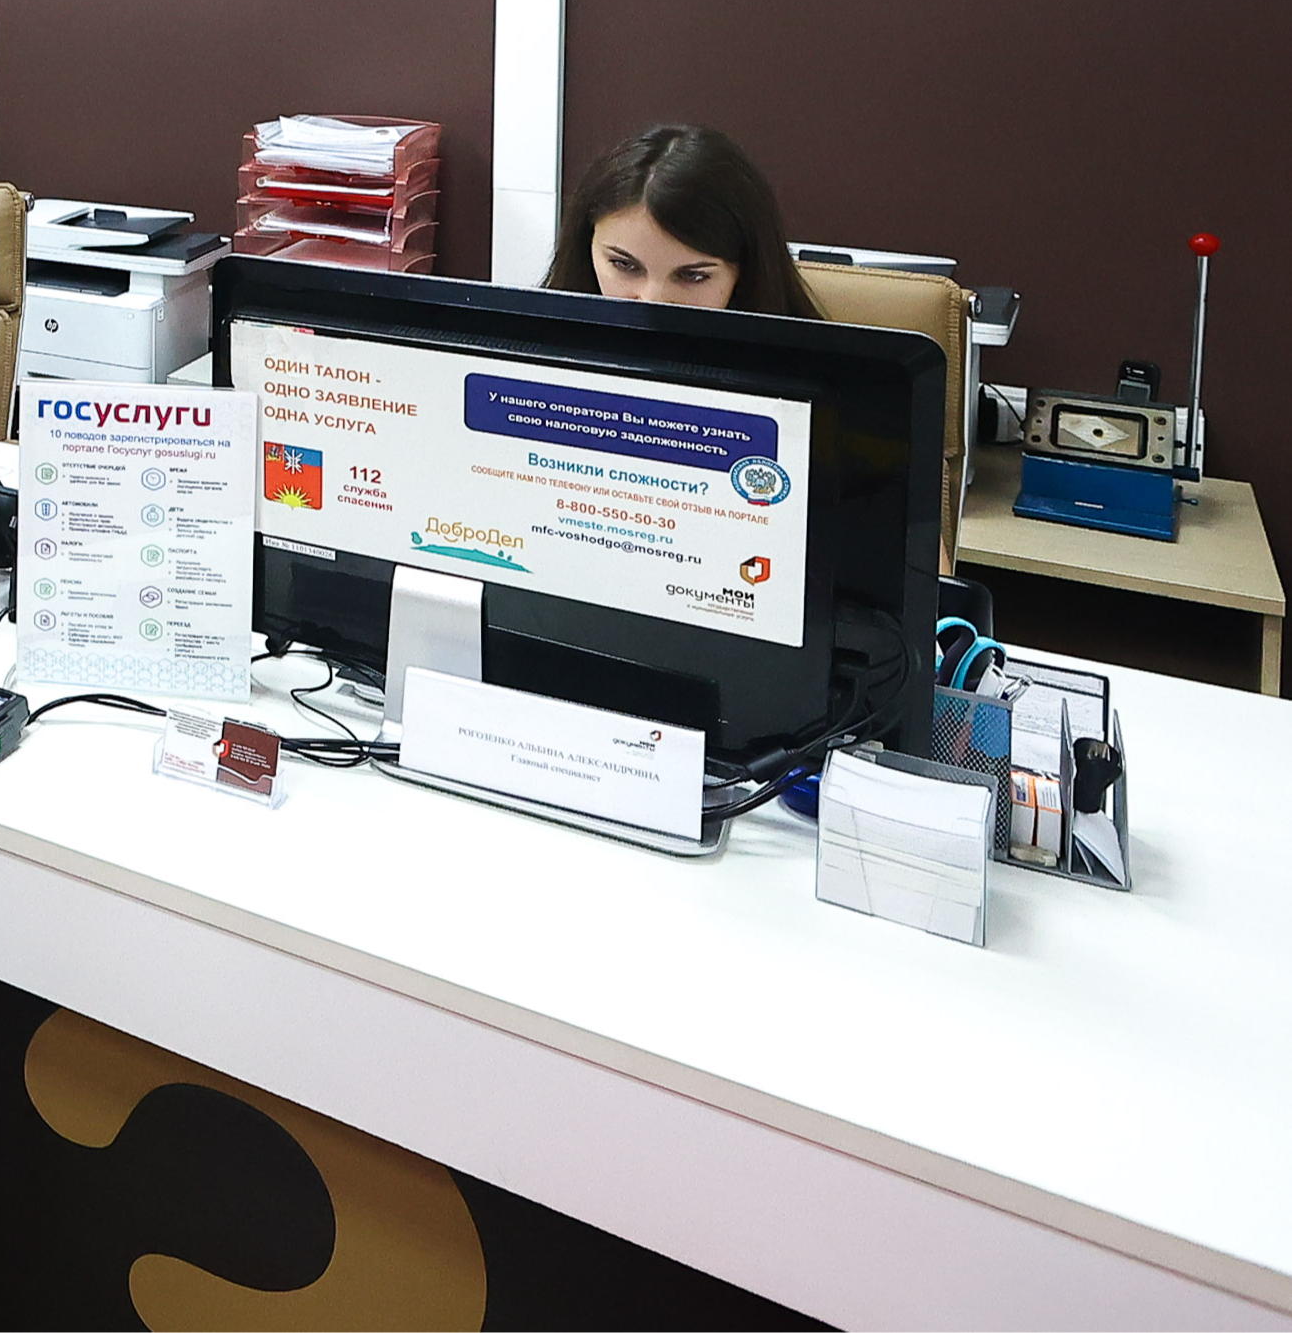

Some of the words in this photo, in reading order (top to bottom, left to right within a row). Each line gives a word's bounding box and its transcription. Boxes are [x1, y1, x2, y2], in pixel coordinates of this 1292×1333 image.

[264, 357, 309, 375] ОДИН
[314, 364, 370, 385] ТАЛОН
[38, 399, 211, 431] госуслуги
[264, 382, 311, 399] ОДНО
[315, 389, 418, 417] ЗАЯВЛЕНИЕ
[264, 405, 309, 423] ОДНА
[314, 413, 377, 436] УСЛУГА
[489, 391, 498, 404] У
[500, 395, 547, 412] нашего
[549, 403, 619, 424] оператора
[622, 412, 644, 425] Вы
[648, 418, 699, 435] можете
[702, 426, 751, 442] узнать
[50, 430, 62, 438] 10
[64, 432, 107, 441] поводов
[110, 434, 215, 447] зарегистрироваться
[218, 439, 231, 447] на
[508, 412, 542, 428] свою
[545, 418, 617, 440] налоговую
[620, 429, 728, 457] задолженность
[62, 443, 105, 454] портале
[107, 445, 151, 457] Госуслуг
[155, 449, 216, 460] gosuslugi.ru
[349, 465, 381, 484] 112
[527, 451, 605, 479] Возникли
[608, 467, 709, 496] сложности?
[337, 494, 393, 512] спасения
[343, 483, 387, 499] служба
[470, 464, 515, 481] СООБЩИТЕ
[517, 472, 534, 484] НАМ
[535, 475, 547, 486] ПО
[548, 477, 592, 494] ТЕЛЕФОНУ
[593, 486, 610, 497] ИЛИ
[611, 489, 654, 506] ОСТАВЬТЕ
[656, 496, 680, 509] СВОЙ
[681, 501, 712, 515] ОТЗЫВ
[714, 507, 727, 517] НА
[728, 510, 769, 526] ПОРТАЛЕ
[556, 498, 676, 531] 8-800-550-50-30
[557, 515, 674, 545] vmeste.mosreg.ru
[425, 516, 524, 549] ДоброДел
[531, 522, 702, 565] mfc-voshodgo@mosreg.ru
[666, 584, 754, 609] документы
[457, 726, 515, 748] РОГОЗЕНКО
[517, 740, 565, 760] АЛЬБИНА
[567, 753, 660, 782] АЛЕКСАНДРОВНА
[510, 754, 549, 770] Главный
[551, 764, 601, 783] специалист
